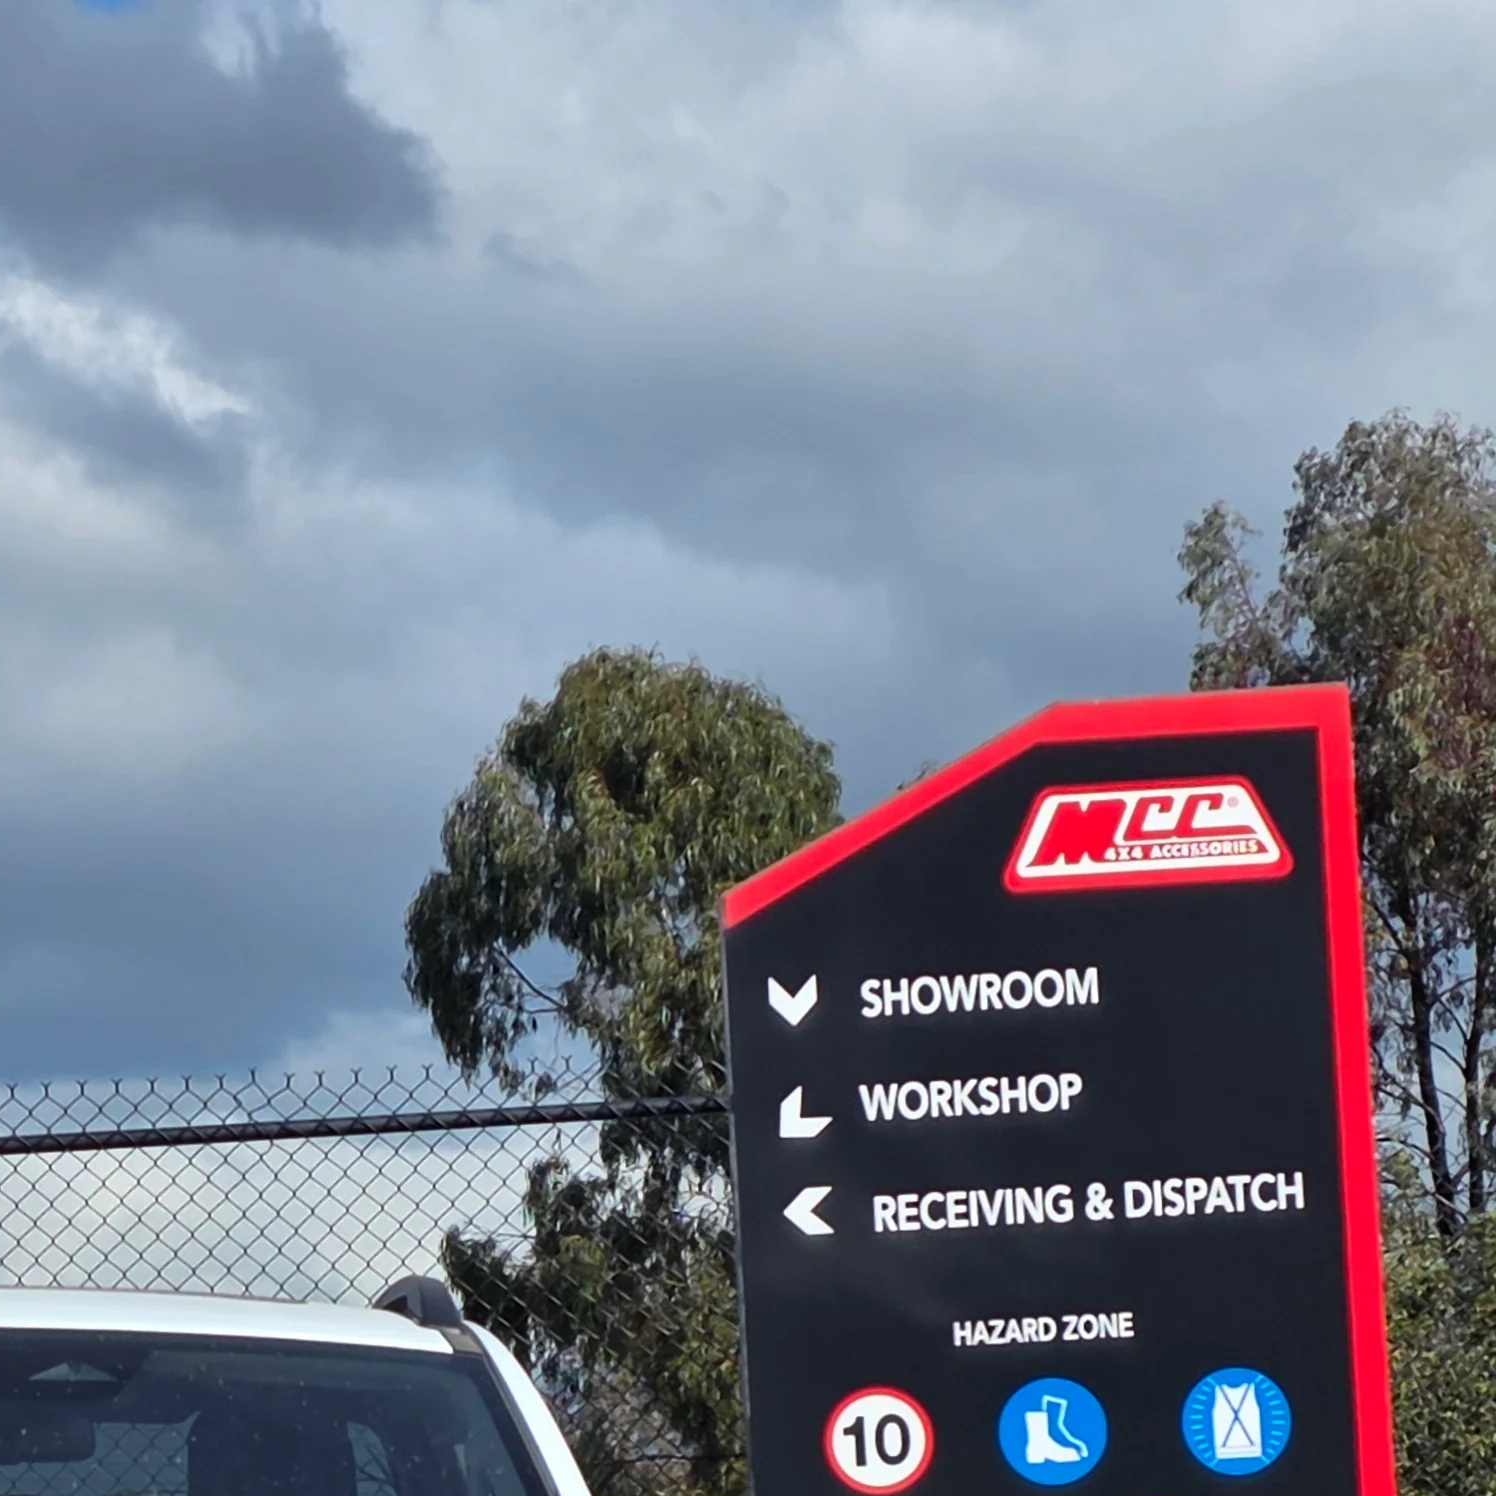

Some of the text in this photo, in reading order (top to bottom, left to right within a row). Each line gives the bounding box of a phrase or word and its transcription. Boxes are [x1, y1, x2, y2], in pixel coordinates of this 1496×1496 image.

[1025, 793, 1257, 867] MCC
[1104, 839, 1258, 861] 4X4 ACCESSORIES
[860, 967, 1099, 1017] SHOWROOM
[859, 1072, 1083, 1122] WORKSHOP
[873, 1172, 1305, 1233] RECEIVING & DISPATCH
[952, 1311, 1135, 1347] HAZARD ZONE
[842, 1413, 911, 1467] 10
